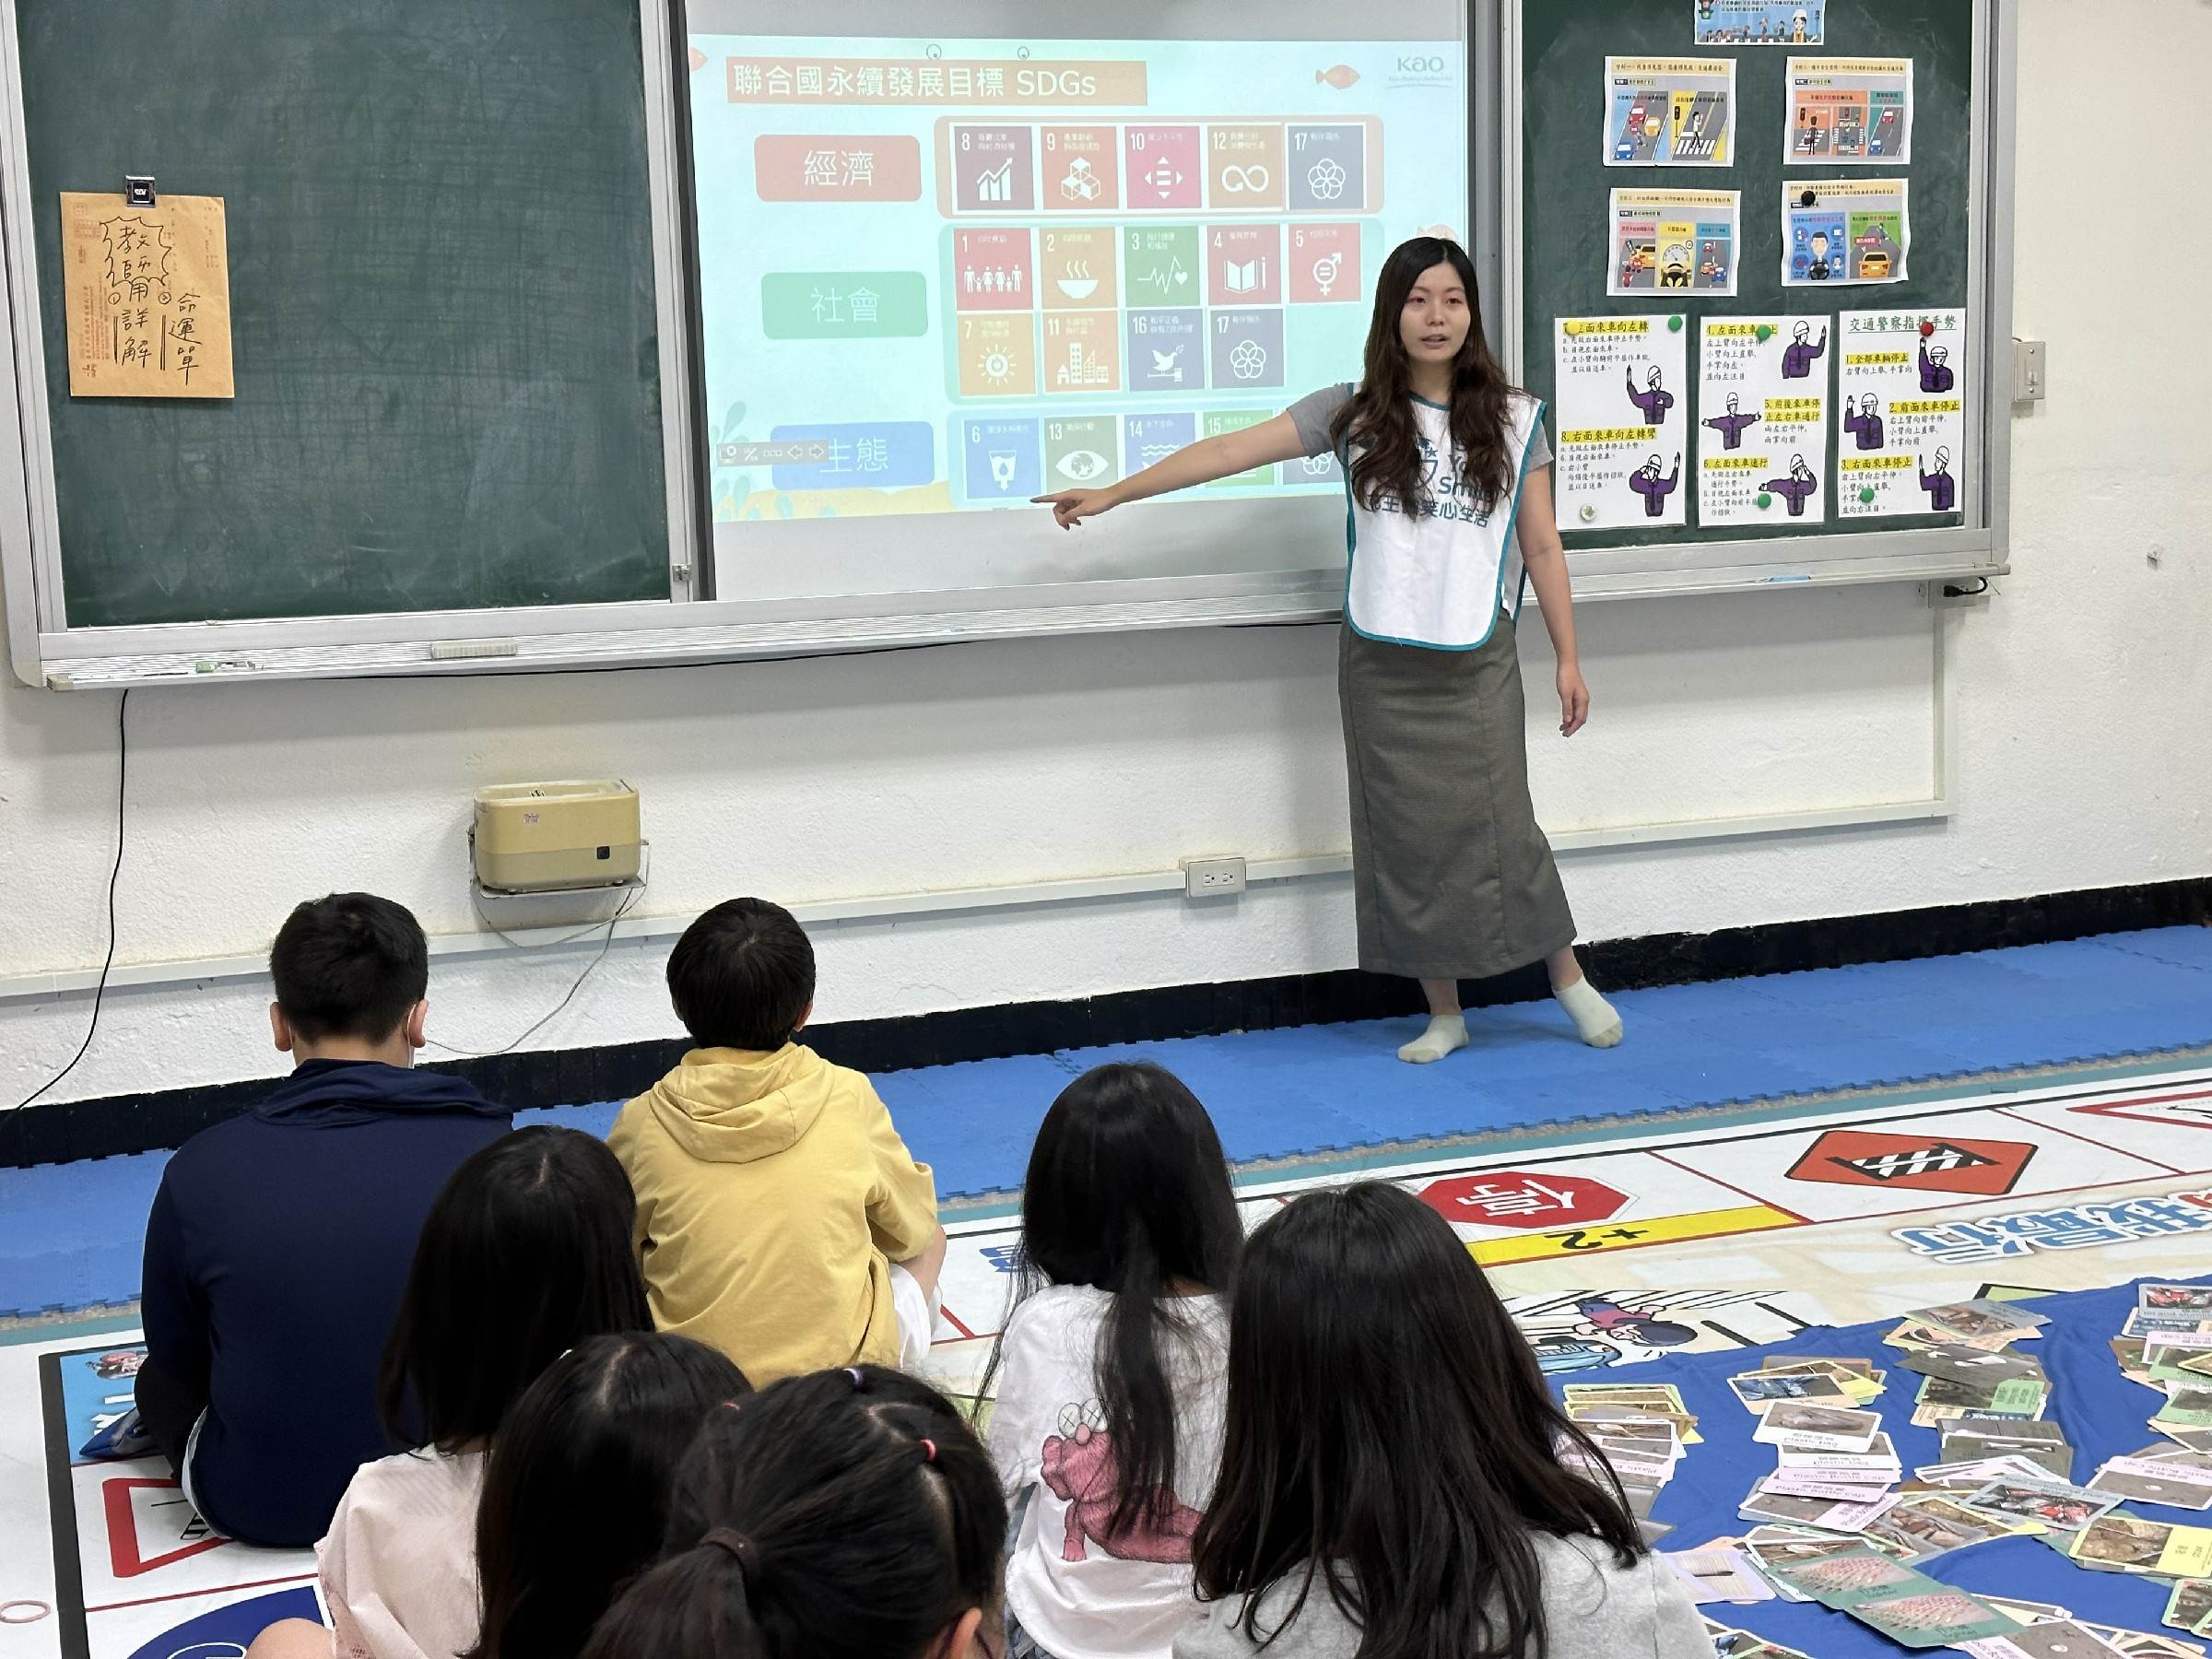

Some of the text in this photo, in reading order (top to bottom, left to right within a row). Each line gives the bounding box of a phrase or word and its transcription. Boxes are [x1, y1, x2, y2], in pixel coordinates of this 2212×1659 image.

[1397, 55, 1444, 72] kao
[734, 65, 1097, 98] 聯合國永續發展目標 SDGs
[961, 133, 971, 151] 8
[1046, 133, 1056, 151] 9
[1130, 132, 1146, 150] 10
[1213, 132, 1227, 150] 12
[1294, 132, 1308, 151] 17
[804, 149, 875, 187] 經濟
[962, 234, 969, 253] 1
[1046, 233, 1055, 253] 2
[1131, 232, 1140, 251] 3
[1214, 230, 1223, 248] 4
[1295, 229, 1304, 248] 5
[810, 287, 880, 324] 社會
[964, 320, 973, 339] 7
[1047, 317, 1060, 336] 11
[1132, 315, 1147, 335] 16
[1217, 315, 1230, 334] 17
[971, 426, 981, 443] 6
[1049, 423, 1063, 441] 13
[1129, 419, 1144, 438] 14
[1207, 417, 1221, 434] 15
[819, 437, 888, 473] 生態
[1454, 1179, 1576, 1218] 停
[1544, 1228, 1650, 1251] +2
